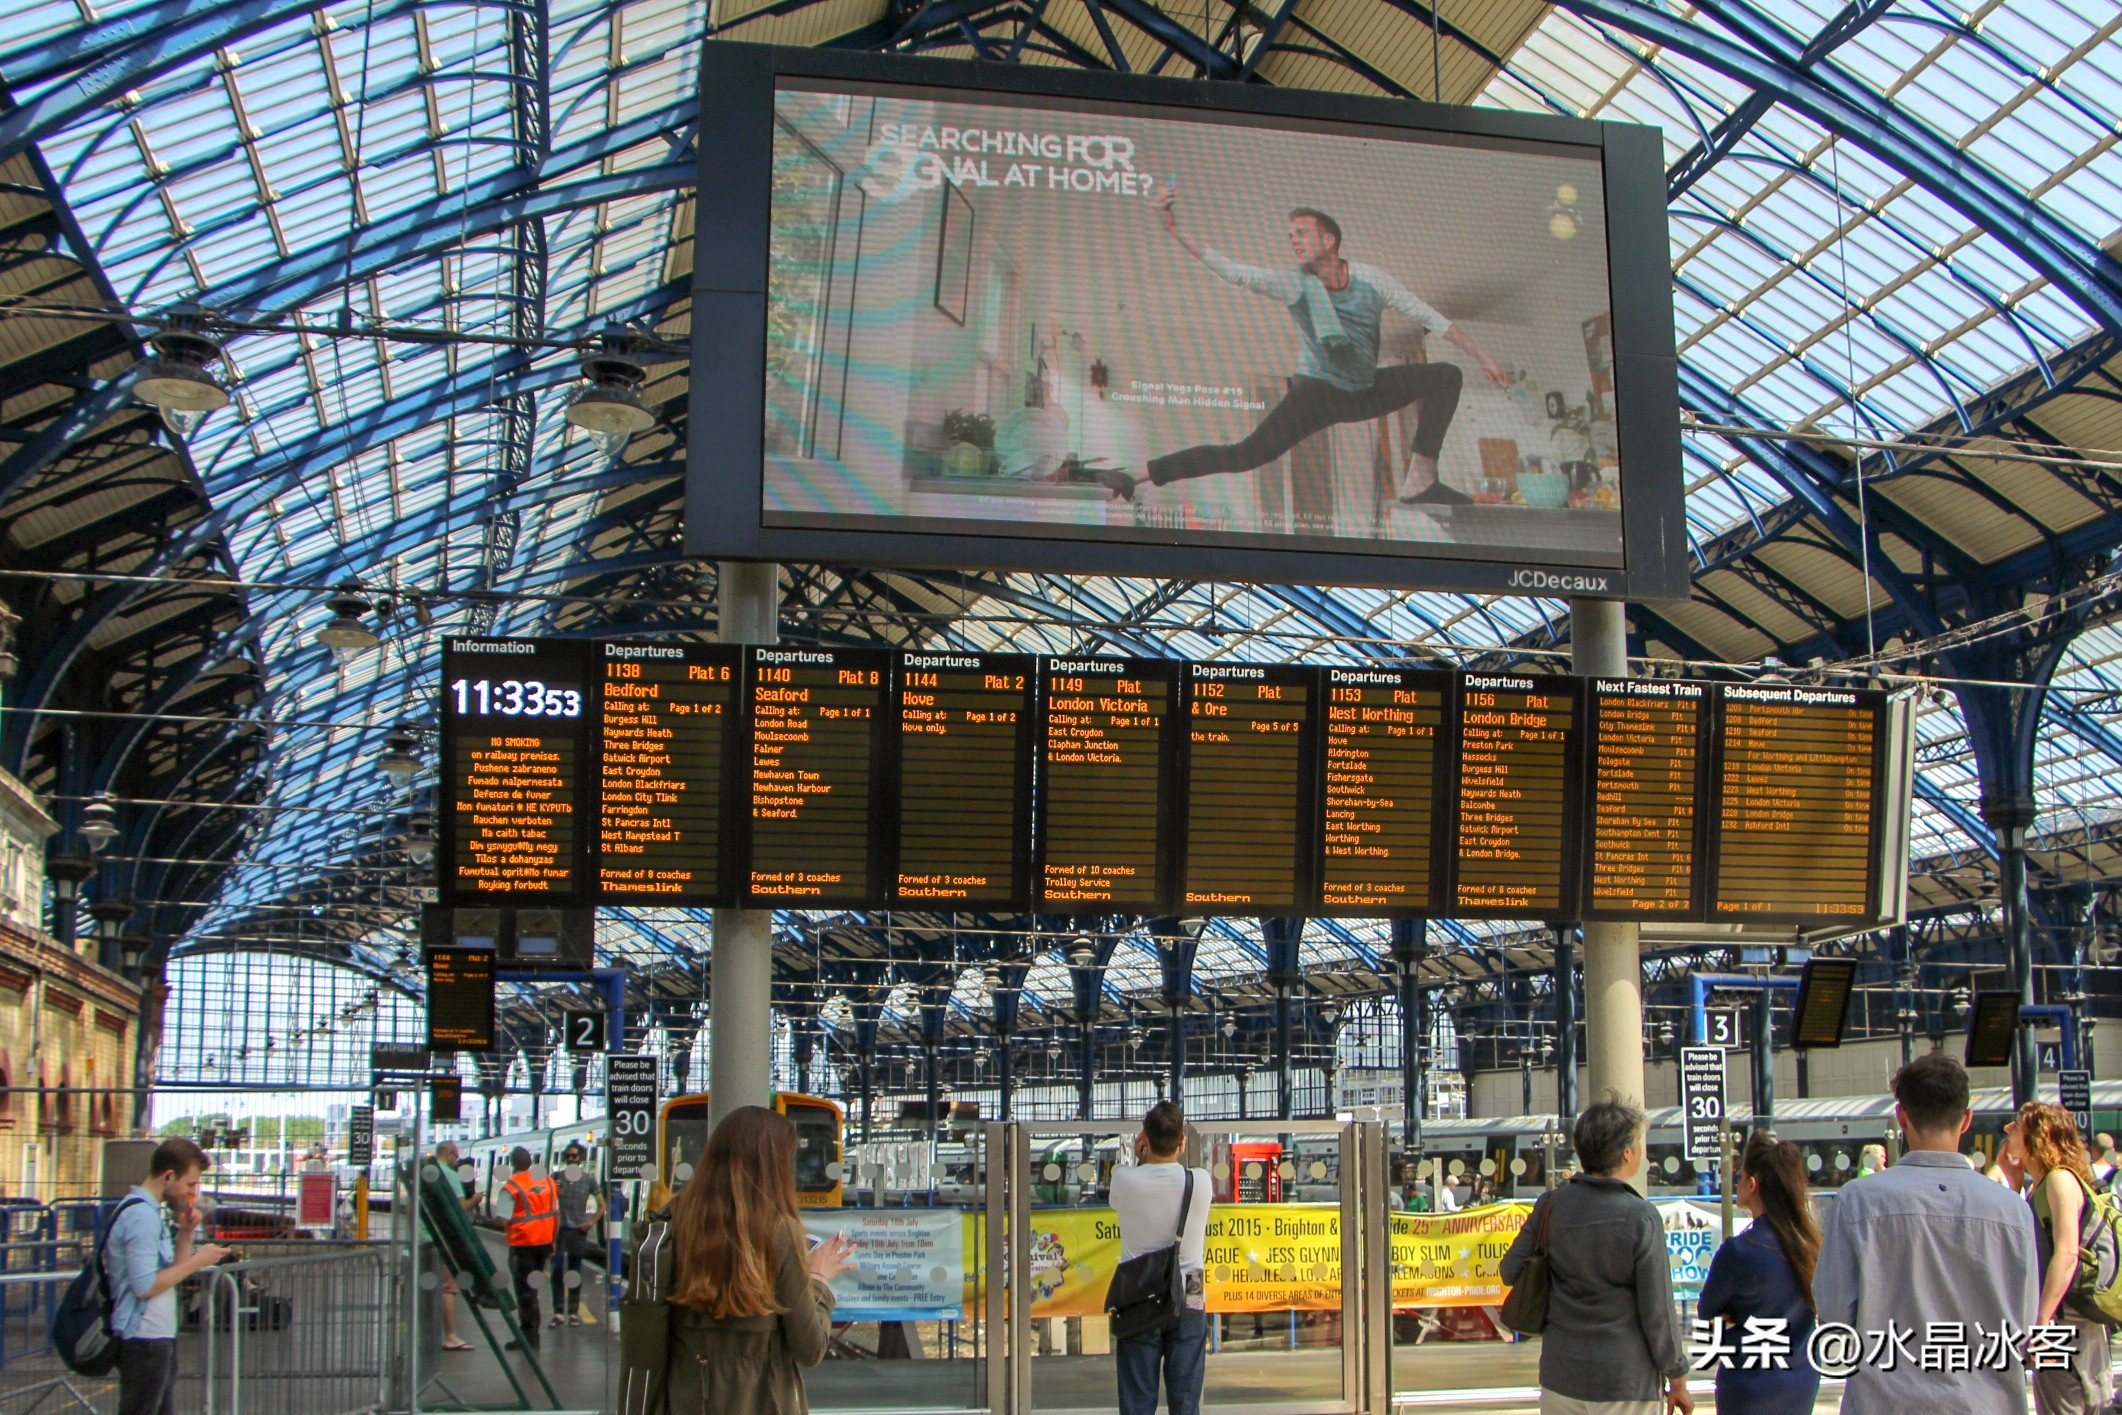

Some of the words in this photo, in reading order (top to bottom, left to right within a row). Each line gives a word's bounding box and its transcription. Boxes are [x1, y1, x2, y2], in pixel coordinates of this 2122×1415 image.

[881, 123, 1062, 158] SEARCHING
[1067, 135, 1135, 171] FOR
[862, 150, 999, 199] SGNAL
[1004, 163, 1042, 187] AT
[1049, 166, 1153, 196] HOME?
[1131, 380, 1163, 393] Signal
[1166, 383, 1192, 394] Yoga
[1194, 385, 1220, 395] Pose
[1111, 392, 1165, 405] Crouching
[1168, 395, 1191, 405] Man
[1193, 396, 1230, 408] Hidden
[1232, 399, 1265, 410] Signal
[1507, 569, 1608, 591] JCDecaux
[453, 639, 535, 654] Information
[605, 644, 684, 659] Departures
[756, 649, 834, 664] Departures
[904, 654, 980, 669] Departures
[606, 663, 641, 677] 1138
[688, 666, 715, 680] Plat
[721, 666, 730, 680] 6
[1050, 659, 1124, 674] Departures
[1192, 664, 1265, 679] Departures
[758, 668, 791, 682] 1140
[838, 670, 864, 684] Plat
[870, 671, 879, 685] 8
[905, 673, 937, 687] 1144
[984, 675, 1009, 689] Plat
[1015, 676, 1025, 690] 2
[1331, 669, 1402, 684] Departures
[1465, 674, 1534, 689] Departures
[604, 683, 659, 698] Bedford
[1051, 678, 1083, 692] 1149
[1117, 680, 1142, 694] Plat
[1193, 683, 1225, 697] 1152
[1258, 685, 1281, 699] Plat
[1597, 681, 1624, 693] Next
[1627, 683, 1670, 695] Fastest
[1673, 685, 1702, 696] Train
[755, 687, 808, 702] Seaford
[903, 692, 935, 706] Hove
[1331, 688, 1362, 702] 1153
[1394, 690, 1417, 704] Plat
[1465, 692, 1495, 706] 1156
[1526, 695, 1549, 709] Plat
[1724, 686, 1791, 702] Subsequent
[1794, 688, 1856, 703] Departures
[1048, 697, 1094, 712] London
[1099, 698, 1148, 713] Victoria
[1192, 702, 1200, 715] &
[1205, 702, 1227, 716] Ore
[1329, 707, 1357, 720] West
[1362, 708, 1414, 724] Worthing
[1464, 711, 1505, 725] London
[1510, 712, 1547, 727] Bridge
[603, 727, 644, 739] Haywards
[646, 728, 673, 738] Heath
[902, 723, 923, 732] Hove
[1048, 727, 1068, 737] East
[1070, 728, 1104, 740] Croydon
[491, 737, 502, 747] NO
[504, 737, 540, 748] SMOKING
[754, 732, 809, 742] Moulsecoomb
[1191, 732, 1205, 741] the
[1208, 732, 1230, 742] train.
[754, 744, 784, 754] Falmer
[1463, 740, 1493, 750] Preston
[1495, 741, 1514, 750] Park
[471, 752, 482, 760] on
[485, 751, 518, 762] railway
[520, 752, 560, 763] premises.
[754, 757, 780, 767] Lewes
[1462, 752, 1497, 762] Hassocks
[1598, 757, 1630, 767] Polegate
[1327, 761, 1367, 770] Portslade
[1327, 773, 1374, 783] Fishersgate
[753, 783, 795, 793] Newhaven
[797, 784, 831, 793] Harbour
[1327, 785, 1365, 794] Southwick
[1597, 781, 1639, 790] Portsmouth
[753, 796, 804, 807] Bishopstone
[602, 805, 648, 816] Farringdon
[1326, 809, 1355, 820] Lancing
[1597, 805, 1626, 813] Seaford
[473, 815, 508, 825] Rauchen
[512, 816, 552, 826] verboten
[601, 882, 683, 892] Thameslink
[1045, 878, 1077, 889] Trolley
[1079, 878, 1111, 888] Service
[751, 885, 821, 895] Southern
[898, 887, 967, 898] Southern
[1044, 890, 1111, 900] Southern
[1186, 893, 1251, 903] Southern
[1324, 895, 1387, 904] Southern
[1458, 897, 1529, 907] Thameslink
[576, 1017, 595, 1046] 2
[1714, 1015, 1729, 1041] 3
[1688, 1053, 1708, 1061] Please
[1709, 1053, 1718, 1061] be
[2043, 1047, 2055, 1068] 4
[614, 1061, 638, 1069] Please
[1684, 1063, 1709, 1071] advised
[1709, 1063, 1723, 1071] that
[609, 1072, 638, 1080] advised
[639, 1072, 655, 1080] that
[1686, 1073, 1702, 1082] train
[1703, 1073, 1721, 1082] doors
[611, 1084, 629, 1092] train
[631, 1084, 653, 1092] doors
[1701, 1084, 1719, 1092] close
[614, 1096, 628, 1104] will
[629, 1096, 649, 1104] close
[1691, 1096, 1720, 1119] 30
[615, 1110, 649, 1135] 30
[1693, 1124, 1719, 1133] seconds
[353, 1132, 370, 1144] 30
[617, 1154, 636, 1164] prior
[637, 1154, 646, 1162] to
[862, 1218, 889, 1228] Saturday
[905, 1218, 919, 1228] July
[1228, 1218, 1261, 1237] 2015
[1275, 1217, 1325, 1241] Brighton
[1330, 1218, 1337, 1235] &
[850, 1229, 868, 1239] Sports
[907, 1229, 930, 1239] Brighton
[1265, 1247, 1295, 1264] JESS
[1420, 1245, 1451, 1261] SLIM
[1224, 1291, 1243, 1301] PLUS
[1245, 1291, 1254, 1301] 14
[1256, 1290, 1287, 1301] DIVERSE
[1288, 1289, 1313, 1300] AREAS
[1416, 1288, 1425, 1297] AT
[1426, 1285, 1500, 1297] BRIGHTON-PRIDE.ORG
[930, 1294, 945, 1303] Entry
